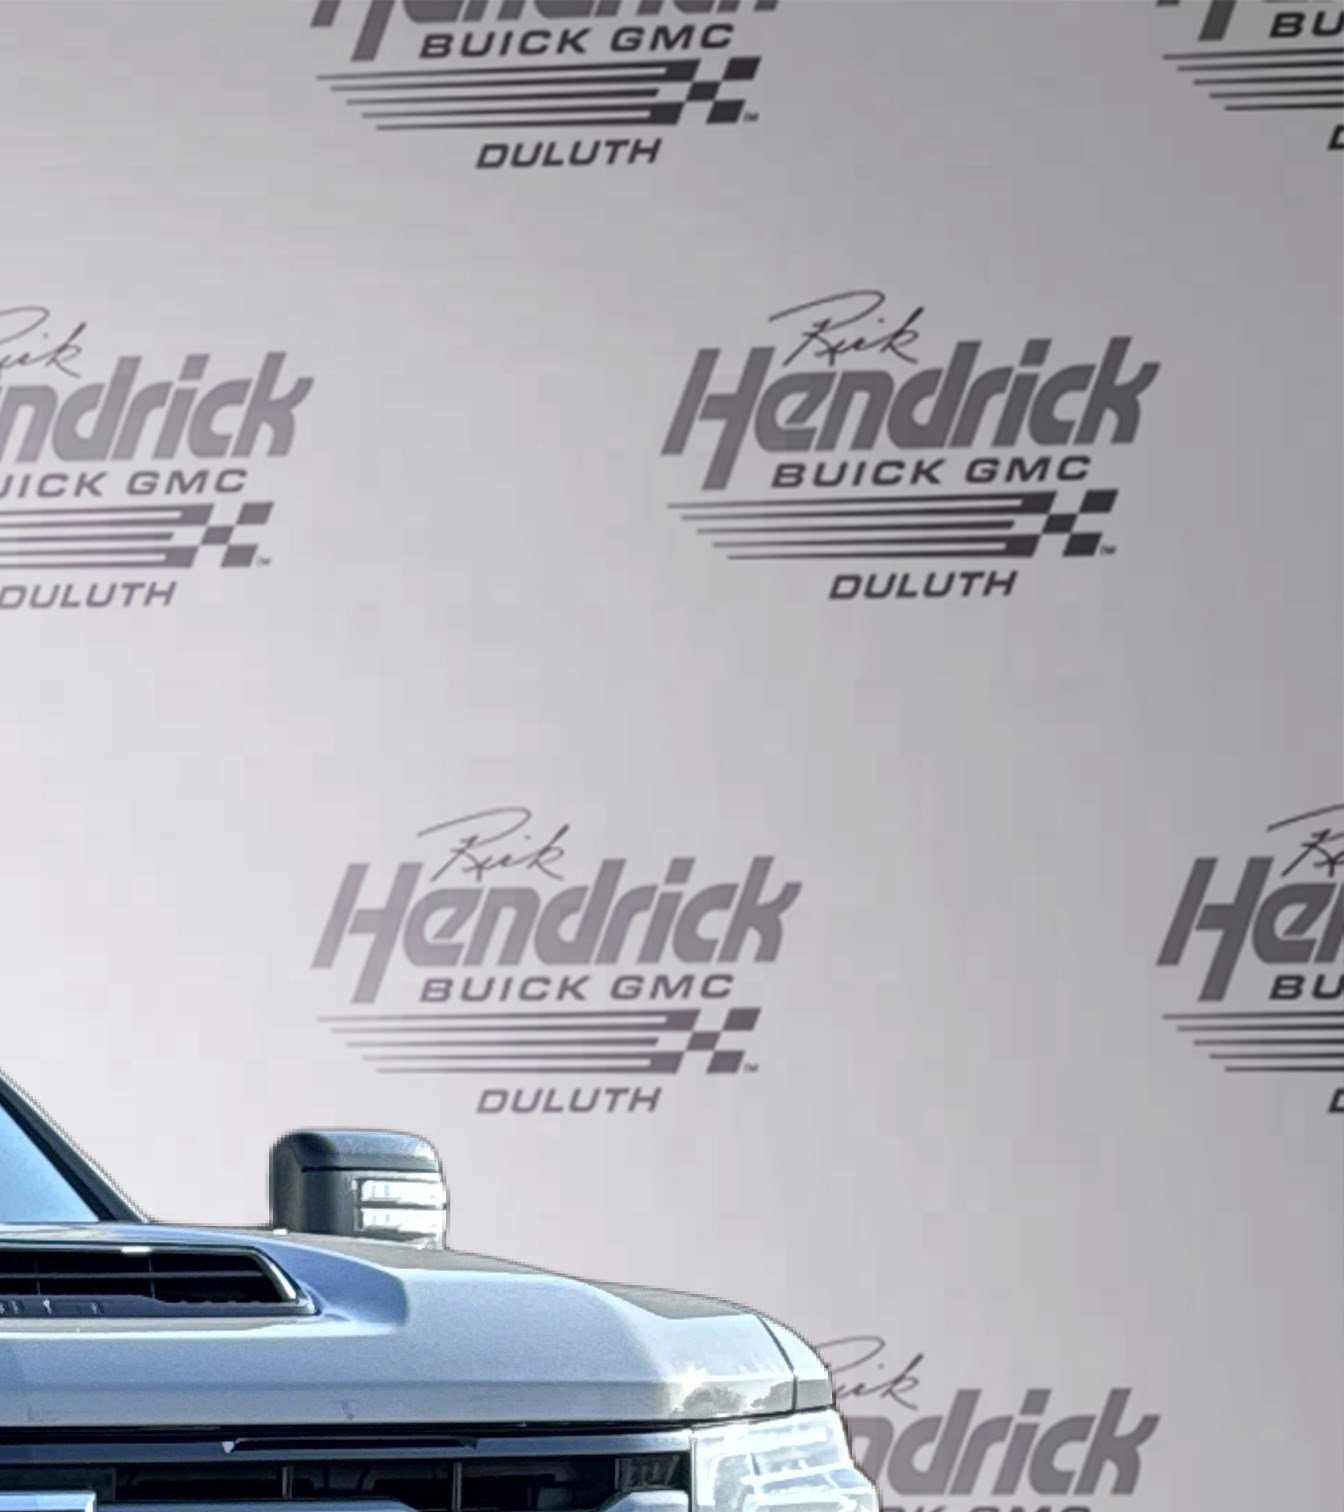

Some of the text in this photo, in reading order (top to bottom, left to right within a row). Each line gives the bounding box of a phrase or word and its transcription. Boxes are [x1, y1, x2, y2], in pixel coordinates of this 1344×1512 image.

[419, 27, 592, 60] BUICK
[610, 23, 736, 53] GMC
[475, 137, 662, 170] DULUTH
[660, 335, 1161, 492] Hendrick
[125, 468, 249, 497] GMC
[770, 455, 1092, 489] BUICK GMC
[827, 569, 1019, 601] DULUTH
[310, 855, 803, 1004] Hendrick
[419, 973, 735, 1003] BUICK GMC
[476, 1086, 662, 1114] DULUTH
[845, 1388, 1161, 1496] ndrick
